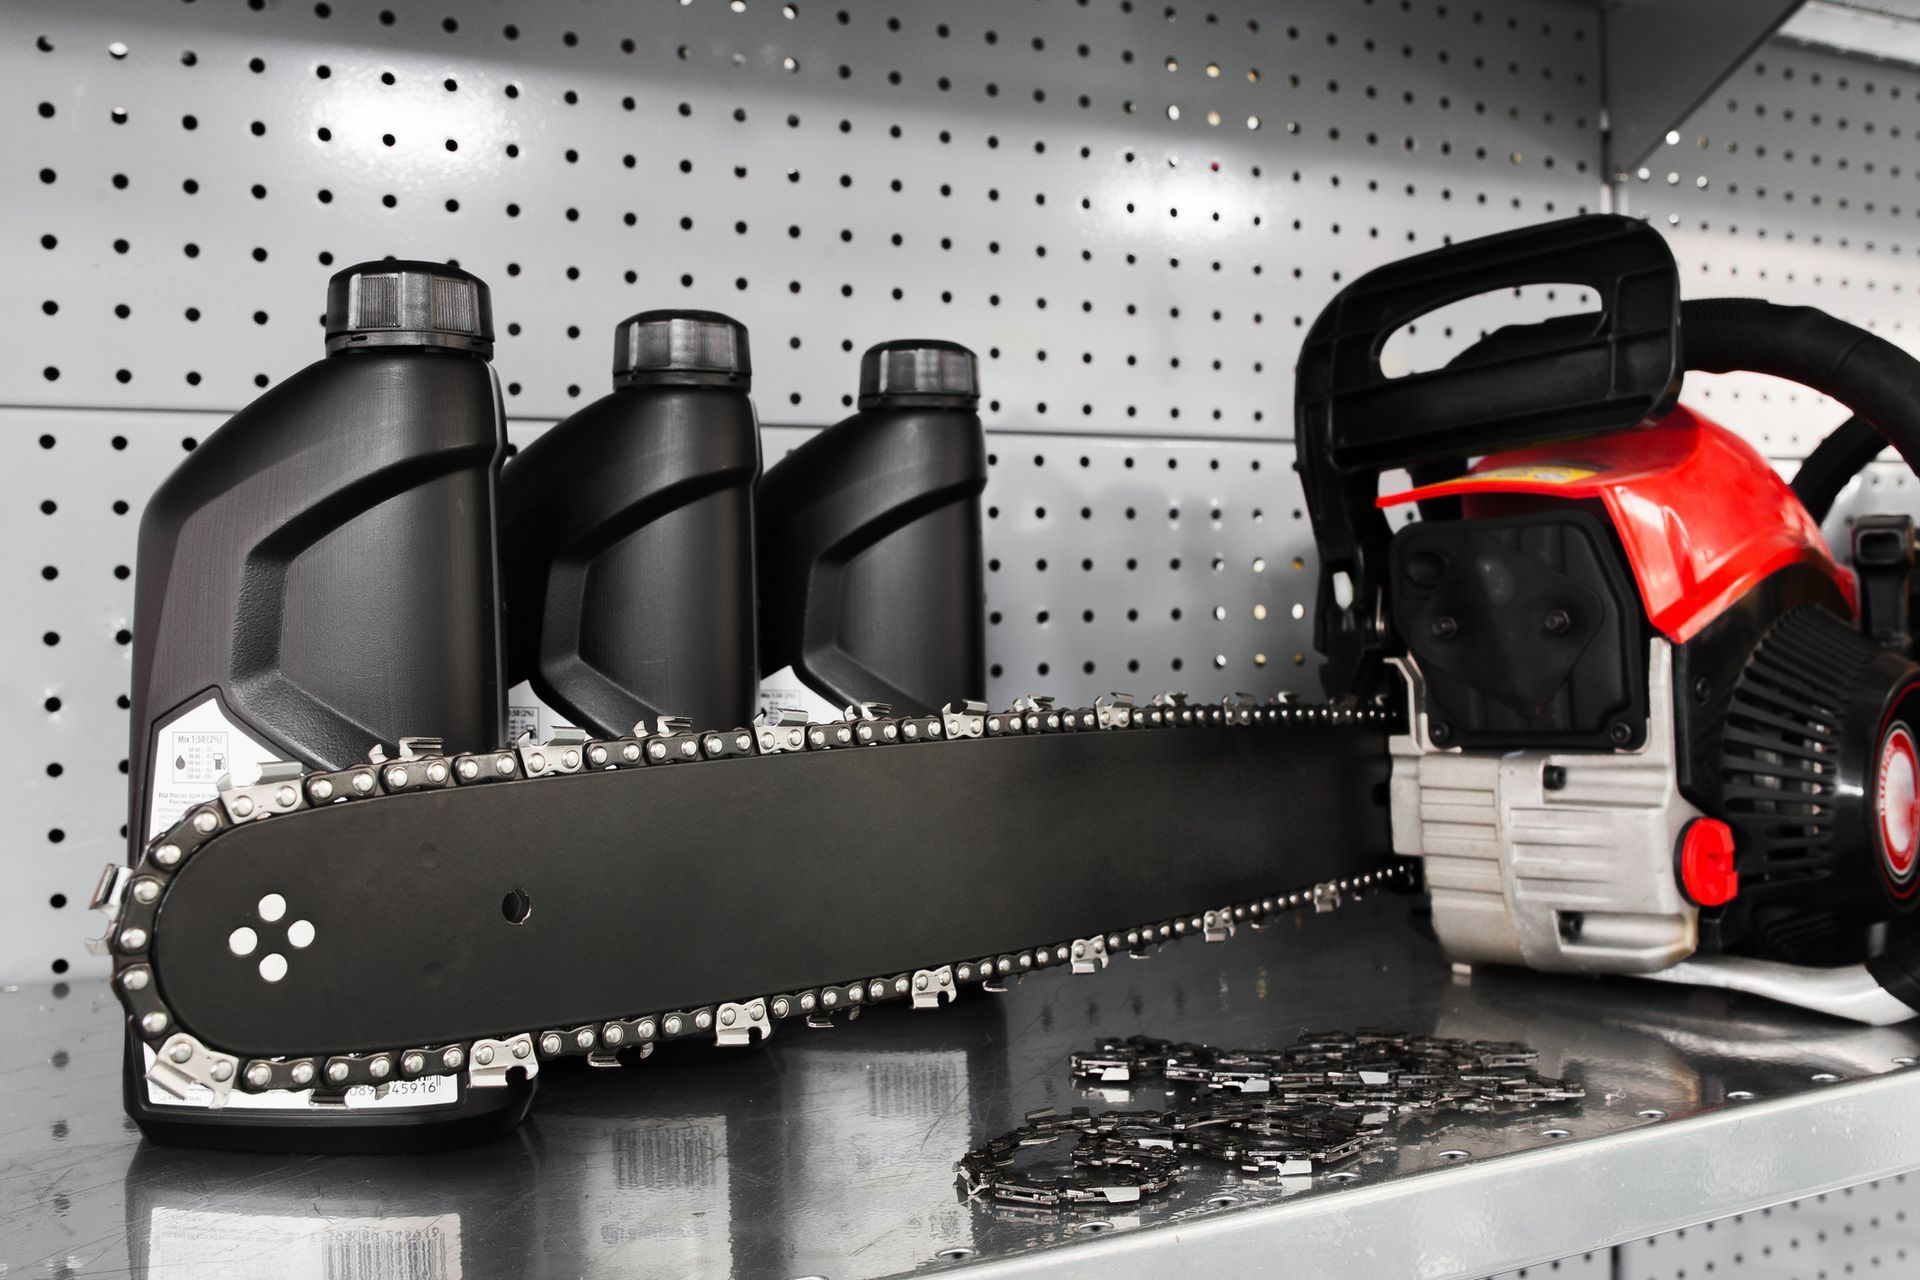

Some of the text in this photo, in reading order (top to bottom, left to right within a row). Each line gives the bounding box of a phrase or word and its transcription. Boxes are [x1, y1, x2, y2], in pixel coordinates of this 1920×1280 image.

[178, 735, 190, 743] Mix
[191, 735, 206, 743] 1:50
[391, 1081, 436, 1095] 45916
